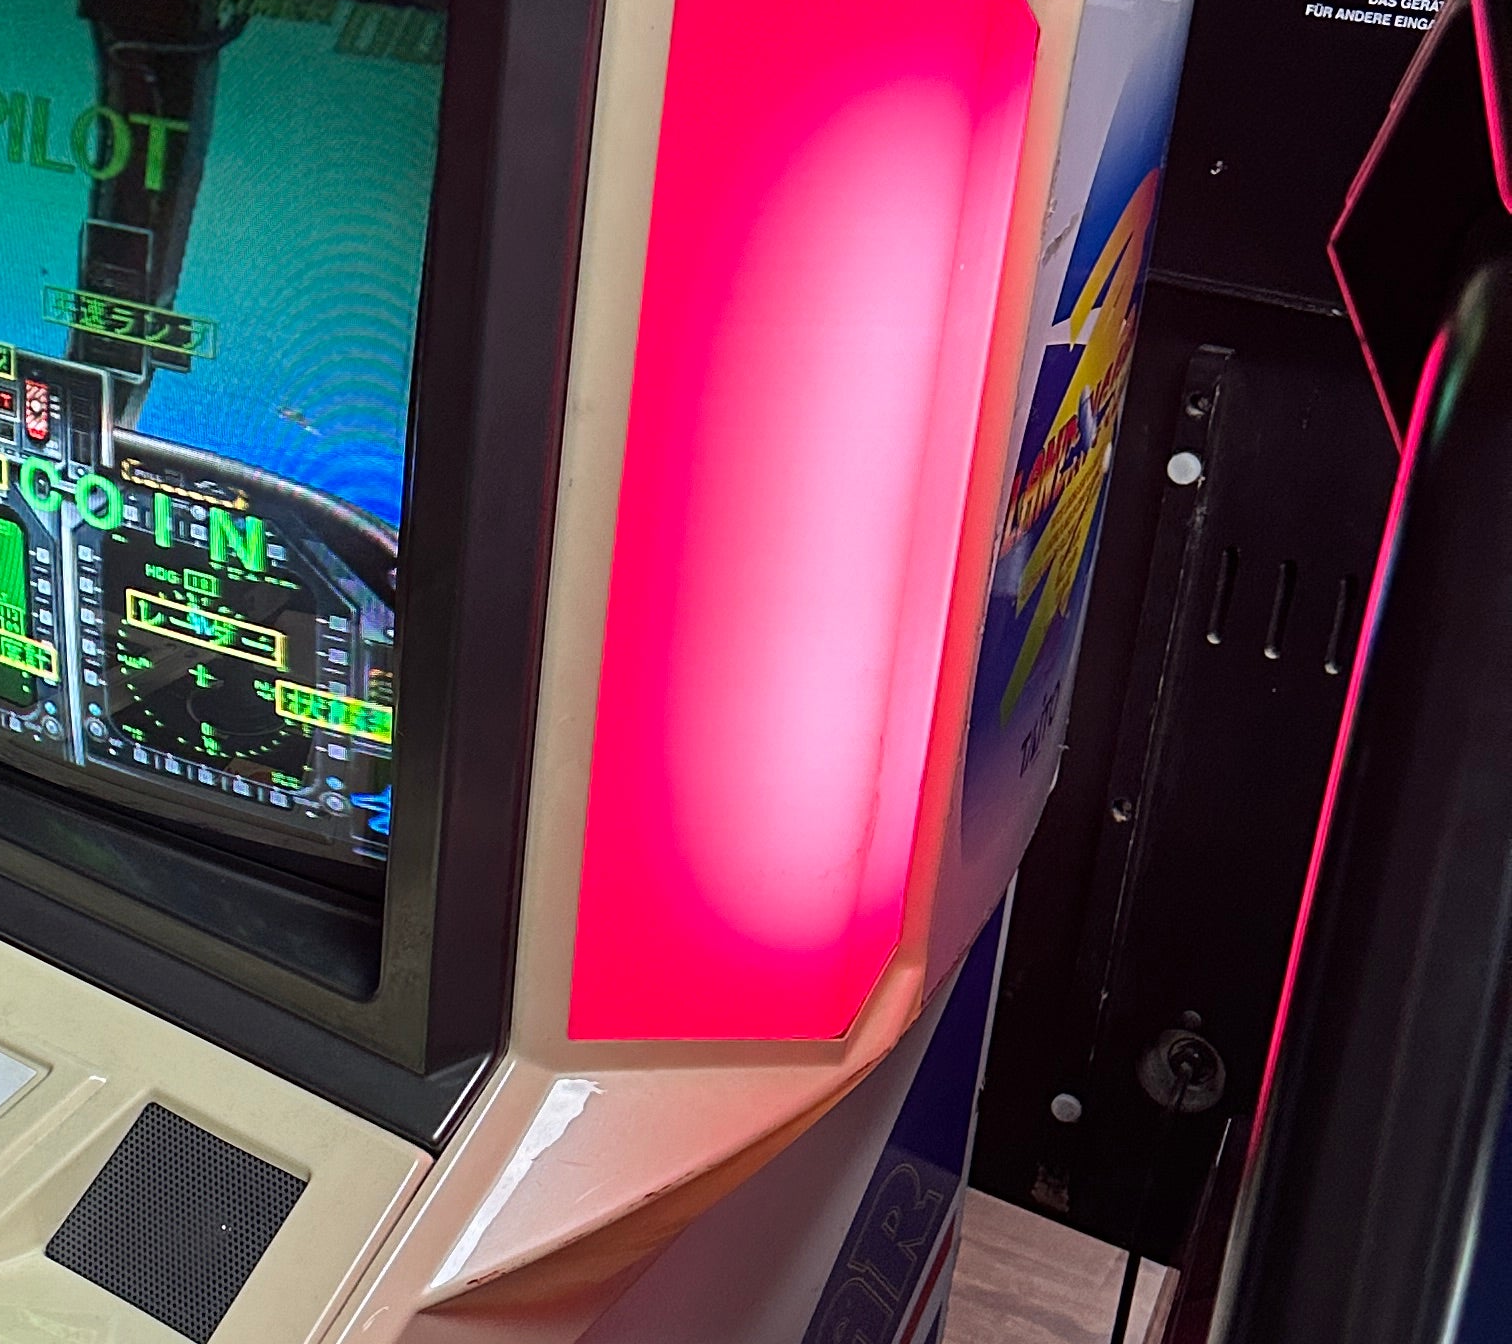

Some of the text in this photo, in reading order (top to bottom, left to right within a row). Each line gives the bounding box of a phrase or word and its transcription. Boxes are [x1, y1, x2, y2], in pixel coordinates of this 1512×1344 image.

[1305, 3, 1333, 18] FÜR
[1335, 10, 1392, 26] ANDERE
[20, 456, 266, 572] COIN
[145, 563, 181, 584] HDG
